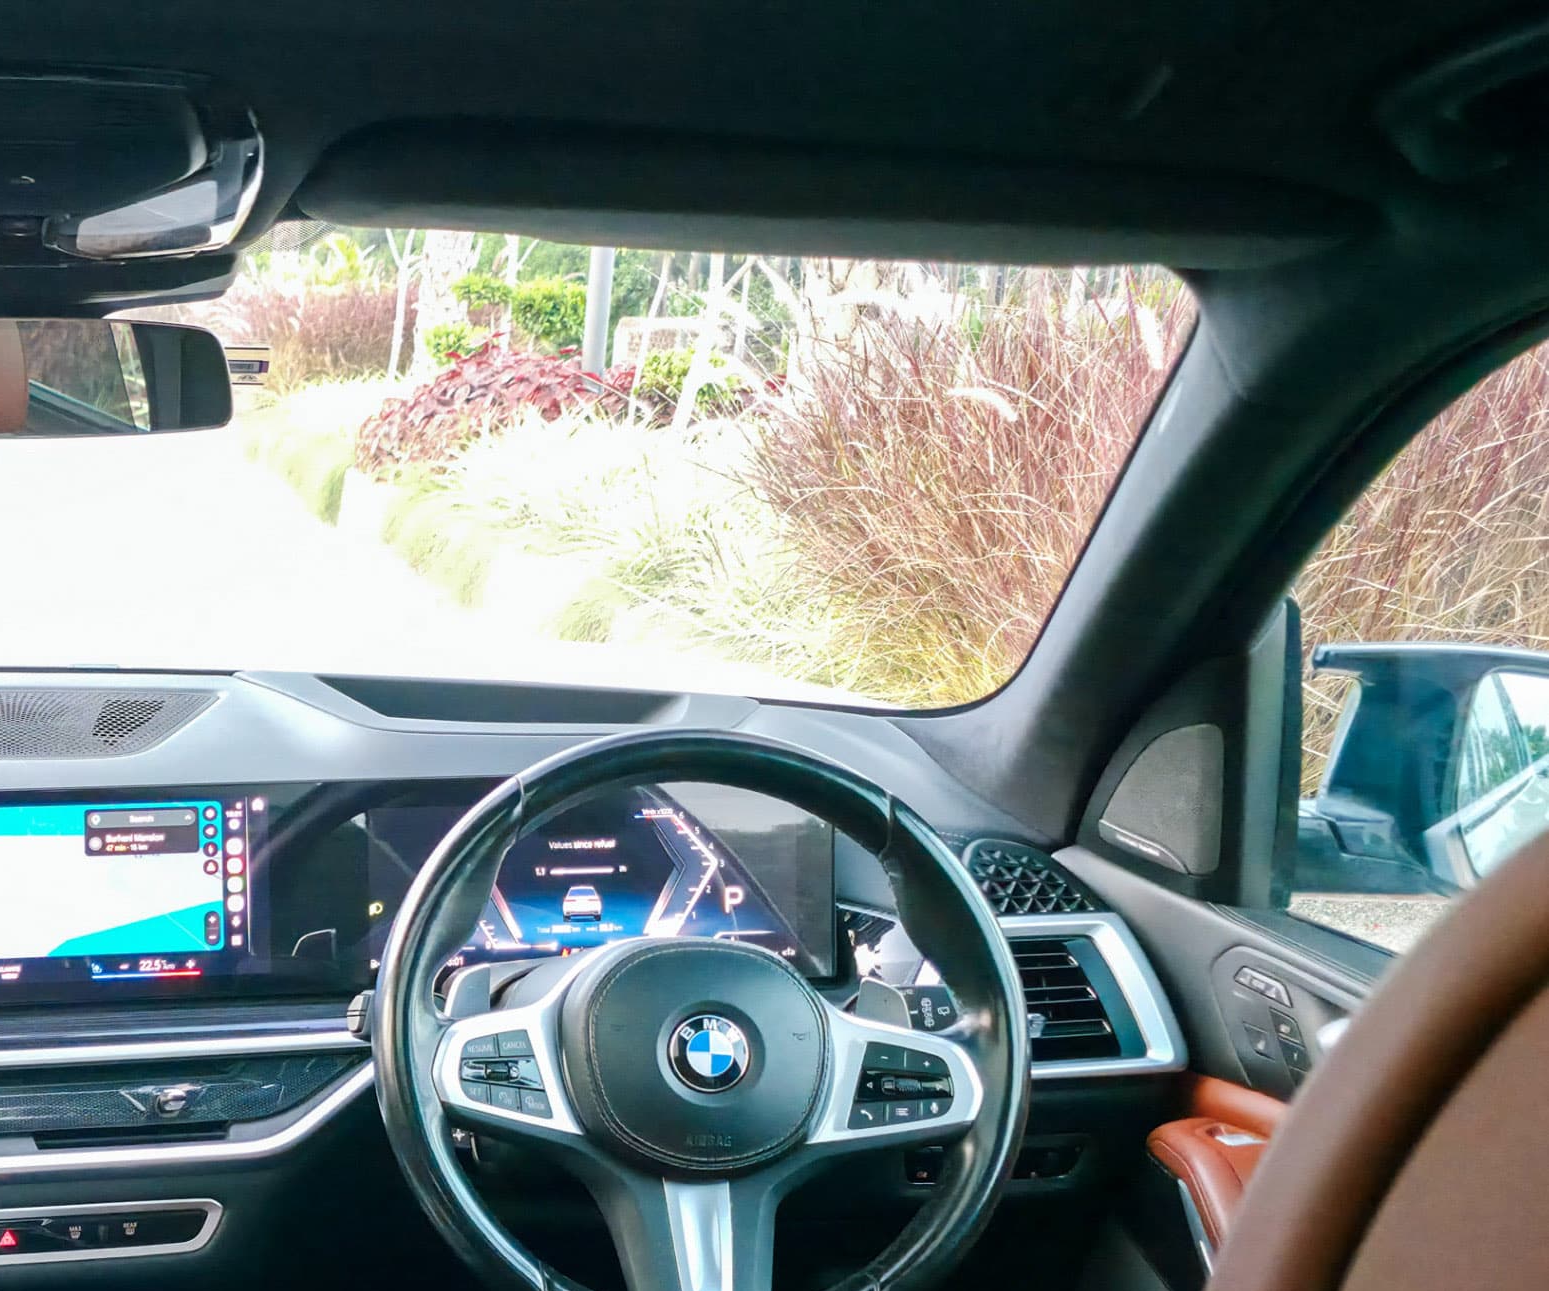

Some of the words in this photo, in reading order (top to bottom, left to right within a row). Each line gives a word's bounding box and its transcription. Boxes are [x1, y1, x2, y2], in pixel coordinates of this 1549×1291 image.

[678, 812, 685, 820] 6
[694, 827, 700, 835] 5
[548, 840, 572, 849] Values
[573, 840, 592, 849] since
[708, 842, 715, 850] 4
[720, 859, 726, 868] 3
[705, 886, 712, 894] 2
[724, 886, 745, 914] P
[139, 959, 162, 972] 22.5
[679, 1018, 741, 1043] BMW
[466, 1044, 494, 1053] RESUME
[502, 1041, 527, 1050] CANCEL
[686, 1135, 732, 1148] AIRBAG
